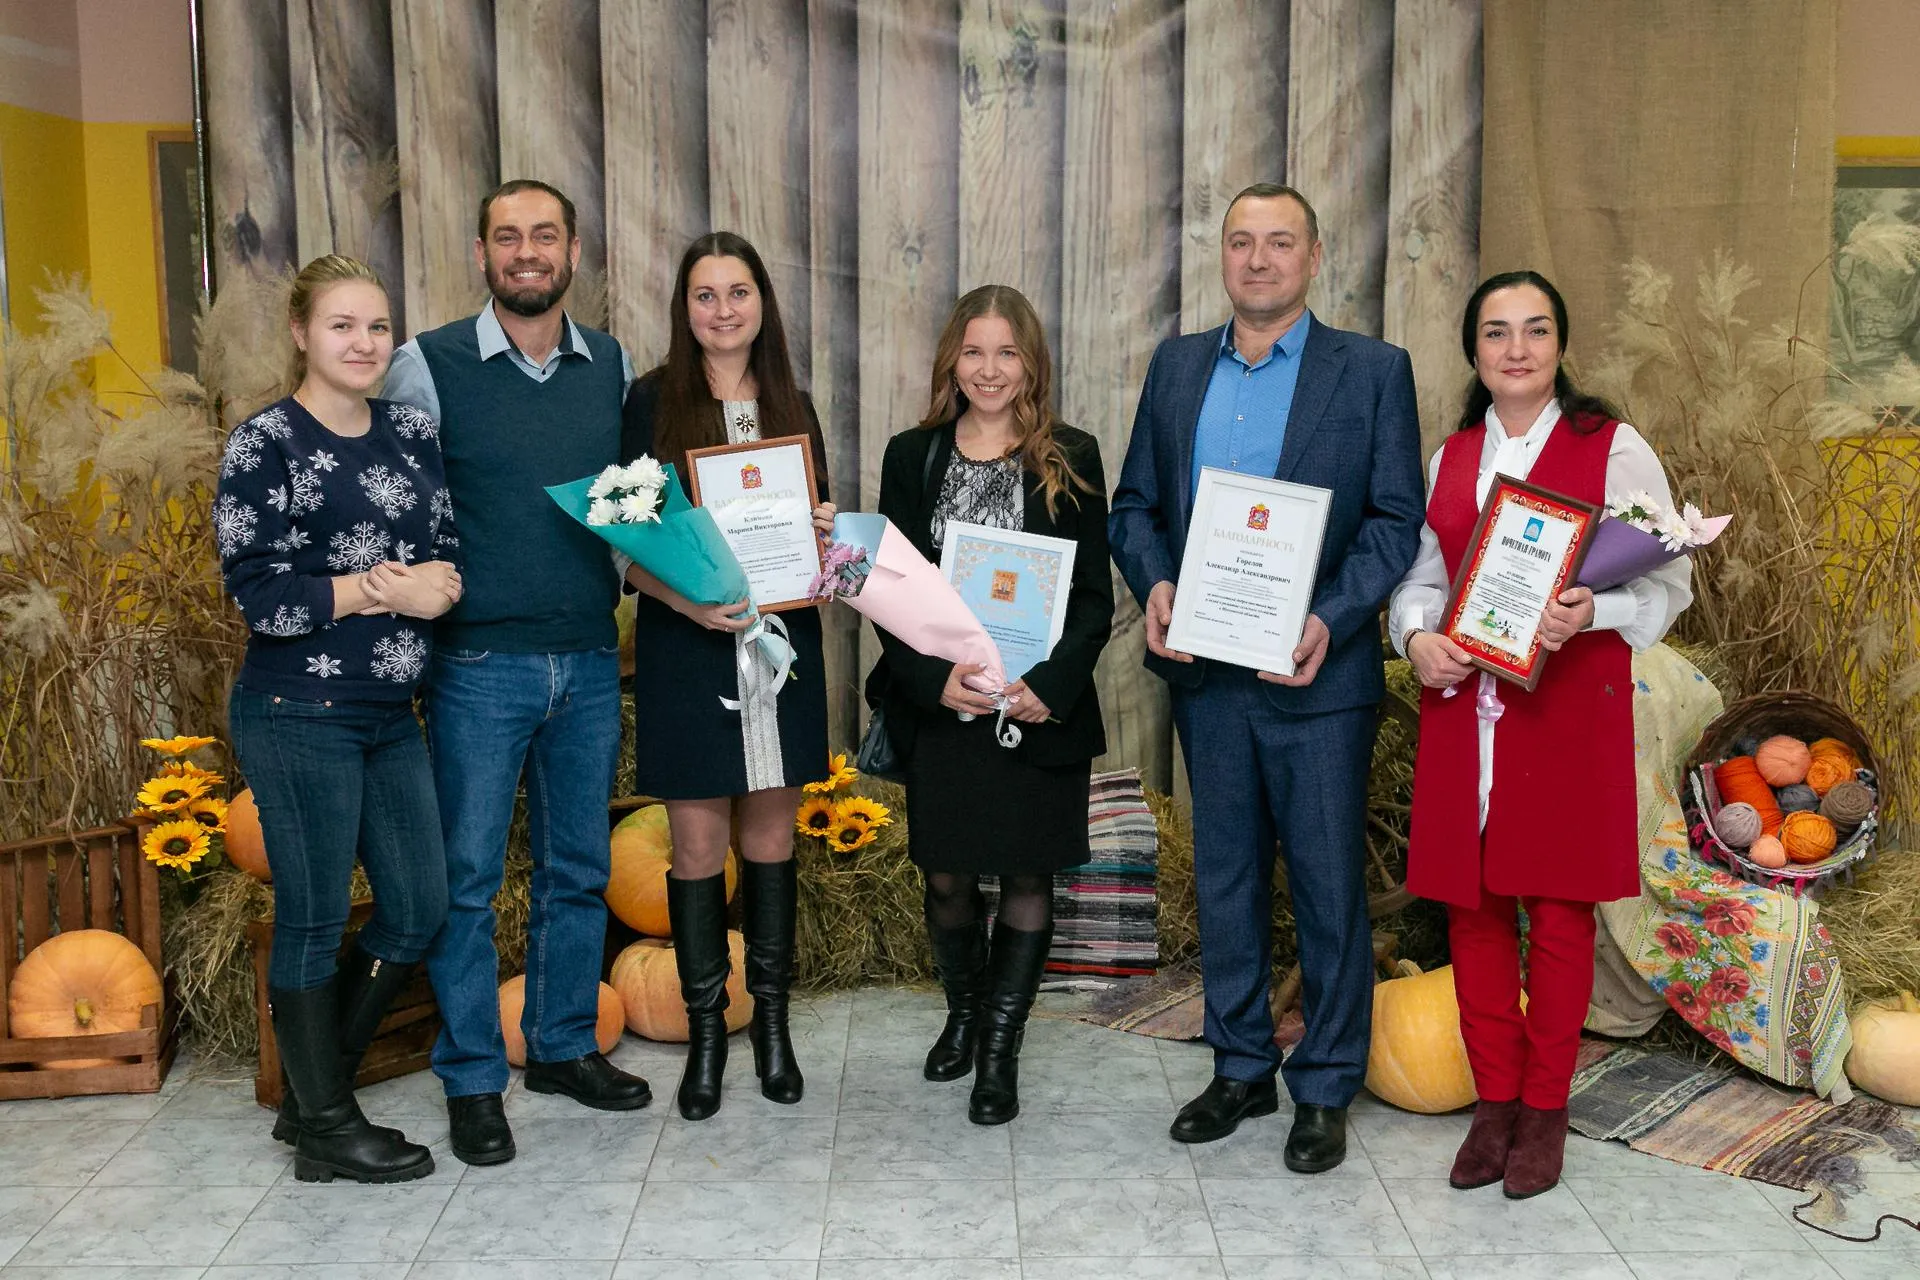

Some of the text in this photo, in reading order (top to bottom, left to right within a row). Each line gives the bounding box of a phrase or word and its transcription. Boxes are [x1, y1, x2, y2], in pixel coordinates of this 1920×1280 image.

[1213, 528, 1295, 553] БЛАГОДАРНОСТЬ
[1205, 561, 1291, 584] Александр Александрович
